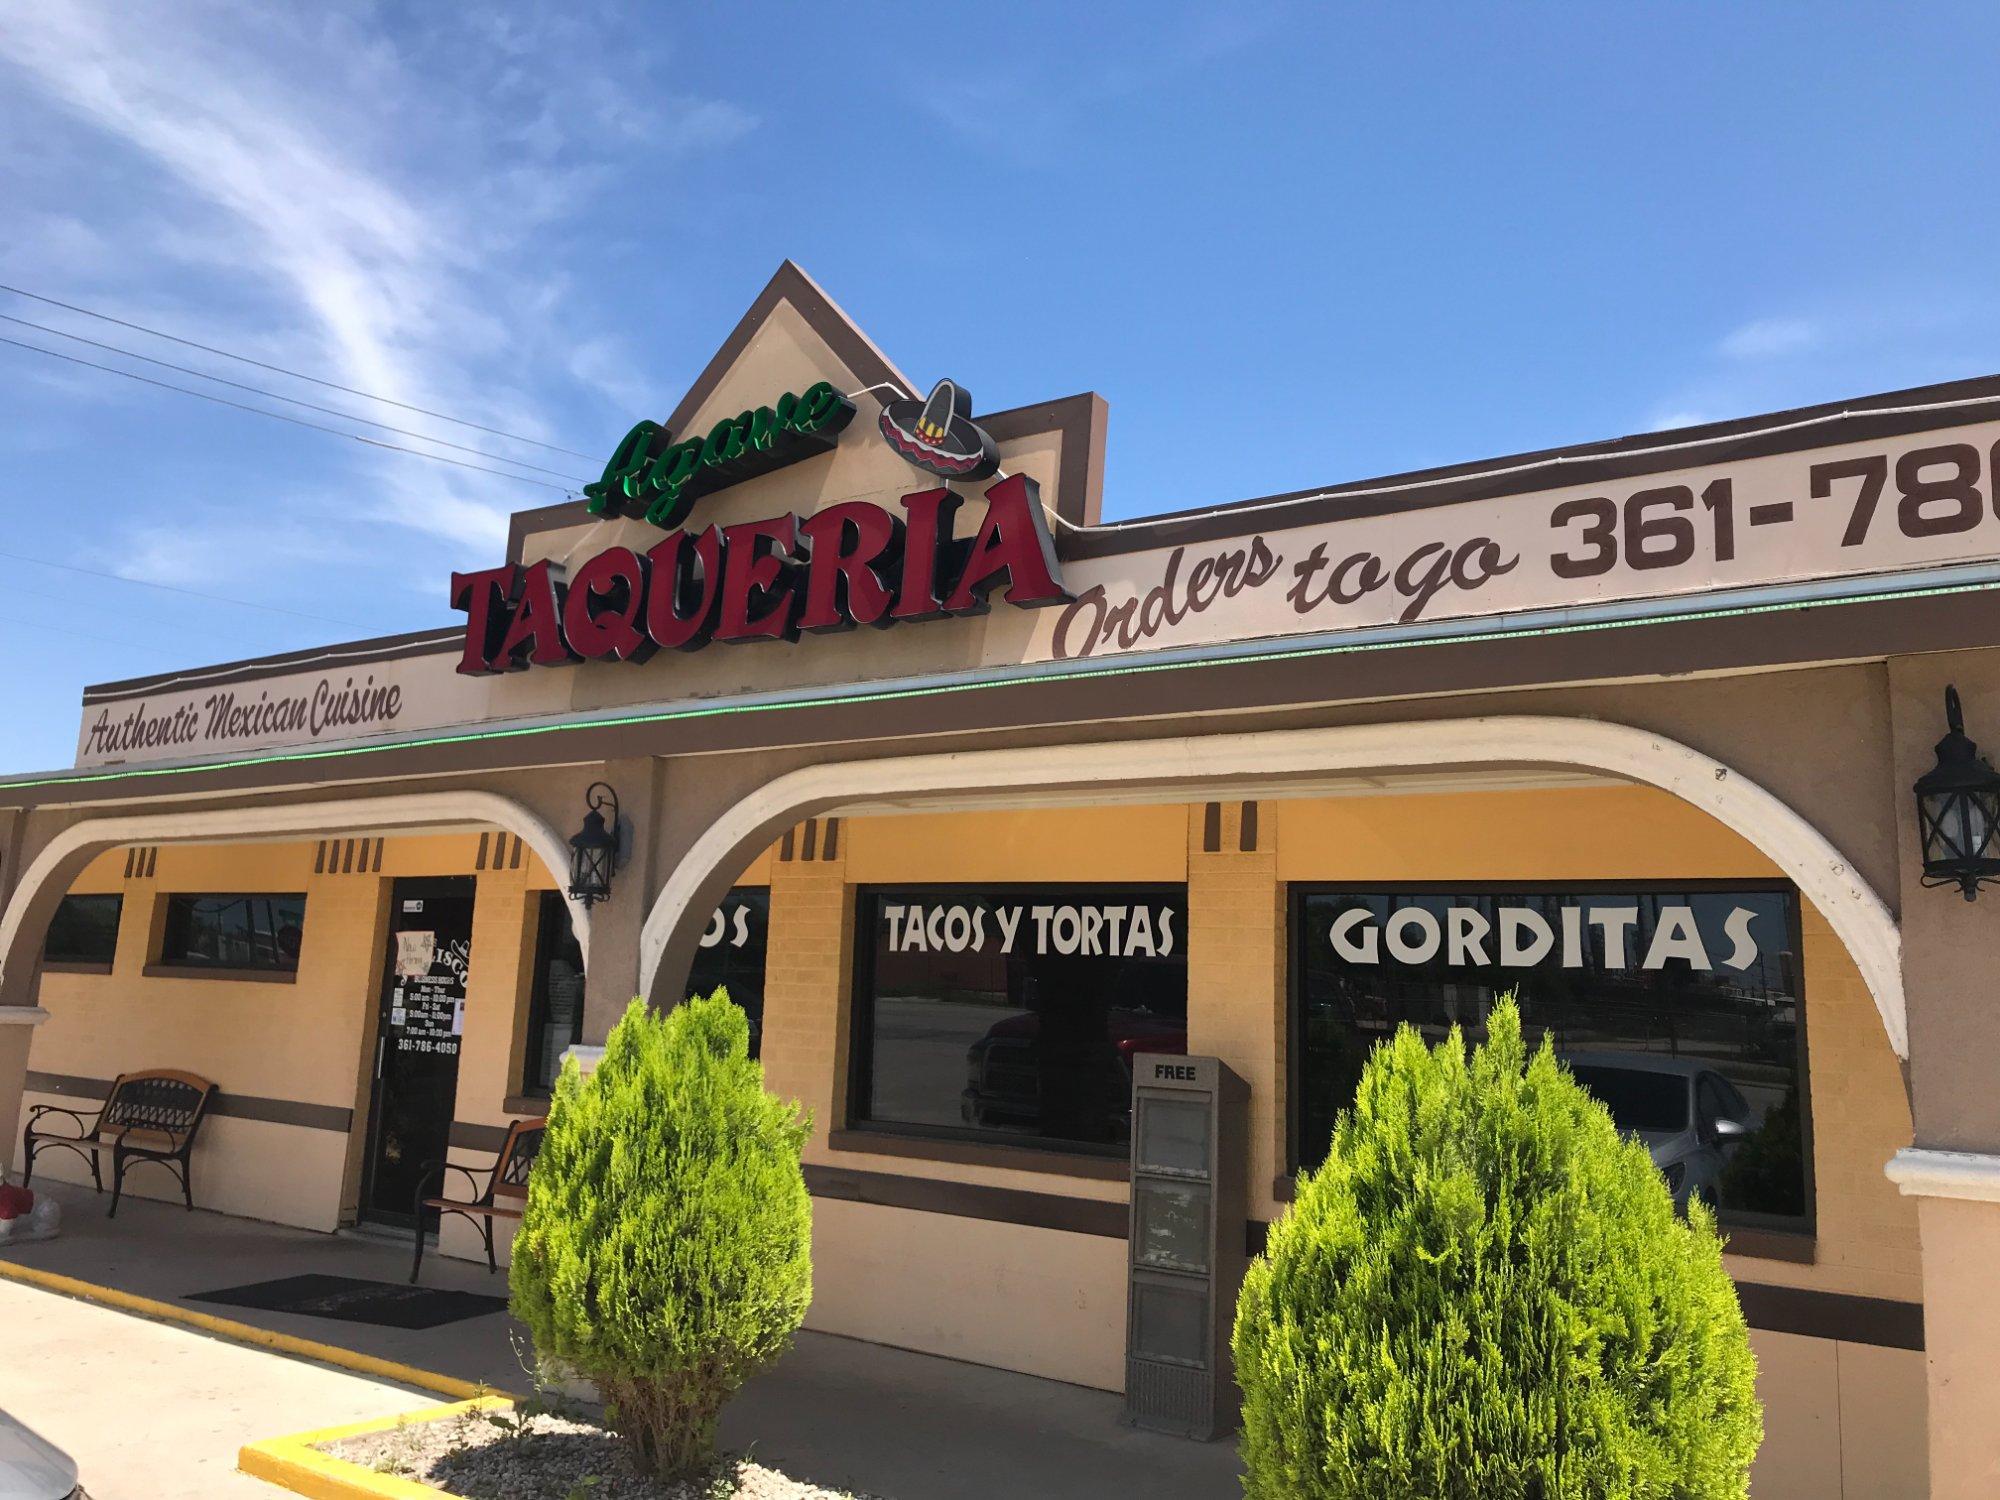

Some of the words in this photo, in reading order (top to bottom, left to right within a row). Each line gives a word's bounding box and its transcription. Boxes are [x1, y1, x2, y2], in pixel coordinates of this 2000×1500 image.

[584, 381, 853, 527] Agave
[451, 472, 1074, 675] TAQUERIA
[1052, 535, 1283, 659] Orders
[1287, 541, 1391, 614] to
[1394, 537, 1521, 623] go
[1550, 440, 2000, 579] 361-78
[84, 701, 199, 756] Authentic
[204, 691, 308, 741] Mexican
[310, 675, 401, 737] Cuisine
[884, 905, 985, 953] TACOS
[996, 906, 1023, 954] Y
[1031, 905, 1175, 957] TORTAS
[1330, 906, 1759, 971] GORDITAS
[398, 1039, 458, 1055] 361-786-4050
[1155, 1063, 1197, 1081] FREE
